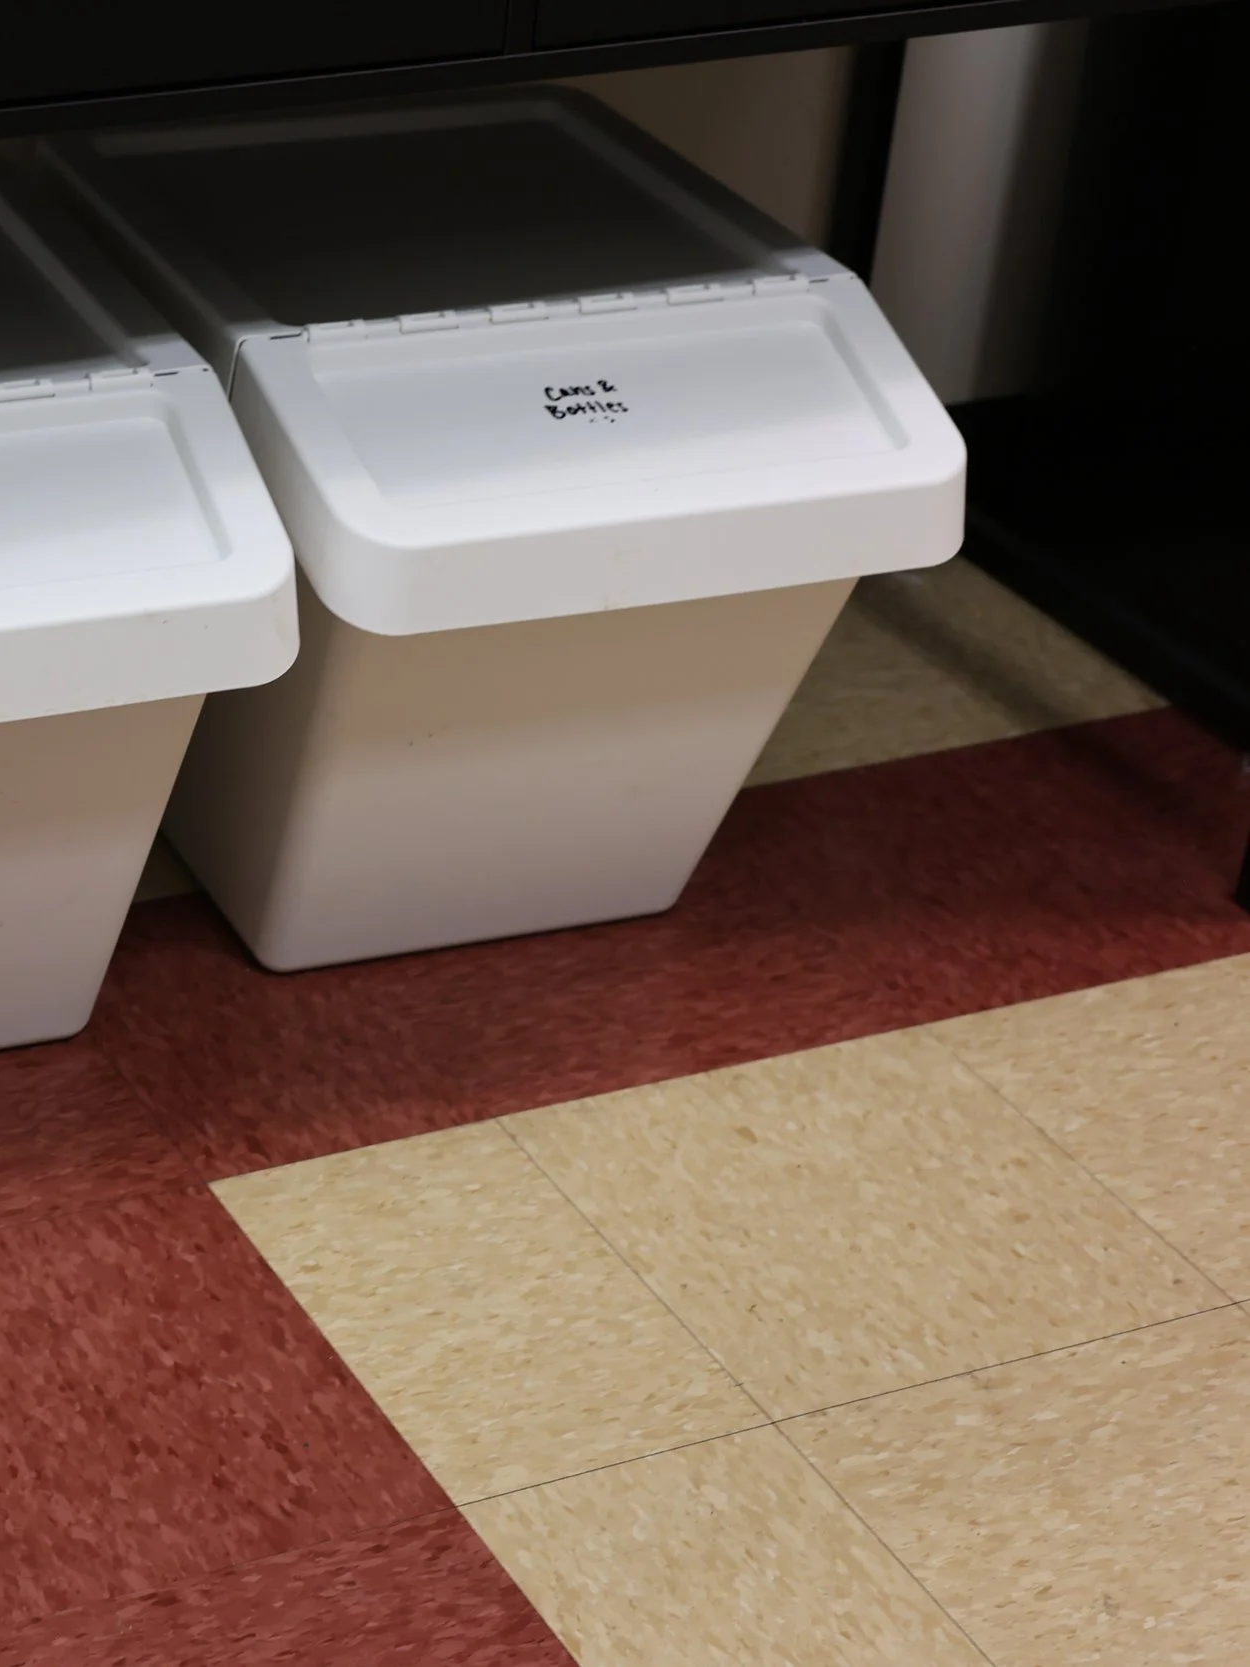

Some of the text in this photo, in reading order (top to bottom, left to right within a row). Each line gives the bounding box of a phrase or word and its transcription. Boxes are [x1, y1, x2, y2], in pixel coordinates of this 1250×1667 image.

[544, 379, 617, 402] Cans &
[543, 400, 629, 419] Bottles
